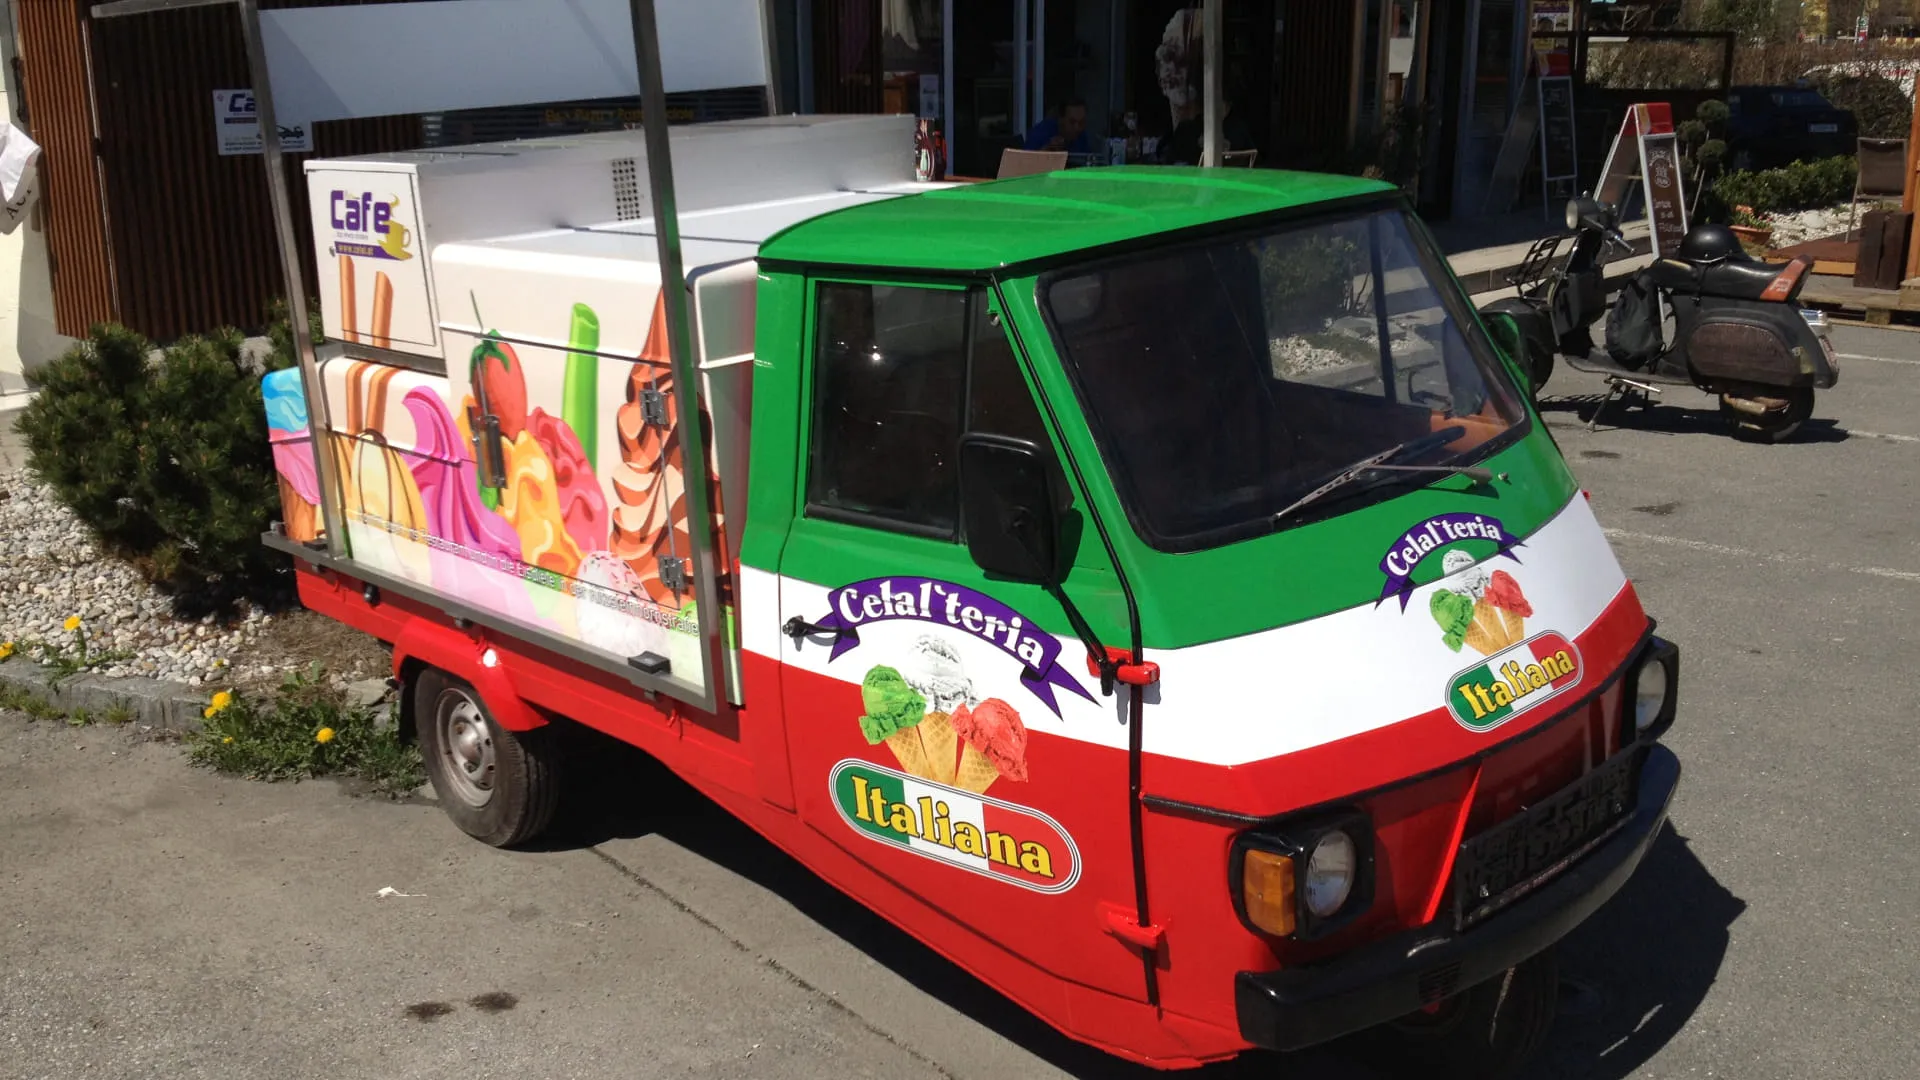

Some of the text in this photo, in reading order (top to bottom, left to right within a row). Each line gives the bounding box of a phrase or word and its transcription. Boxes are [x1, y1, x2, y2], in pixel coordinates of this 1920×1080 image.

[229, 92, 257, 113] Ca
[331, 190, 391, 234] Cafe
[1458, 649, 1576, 719] Italiana
[851, 776, 1054, 878] Italiana
